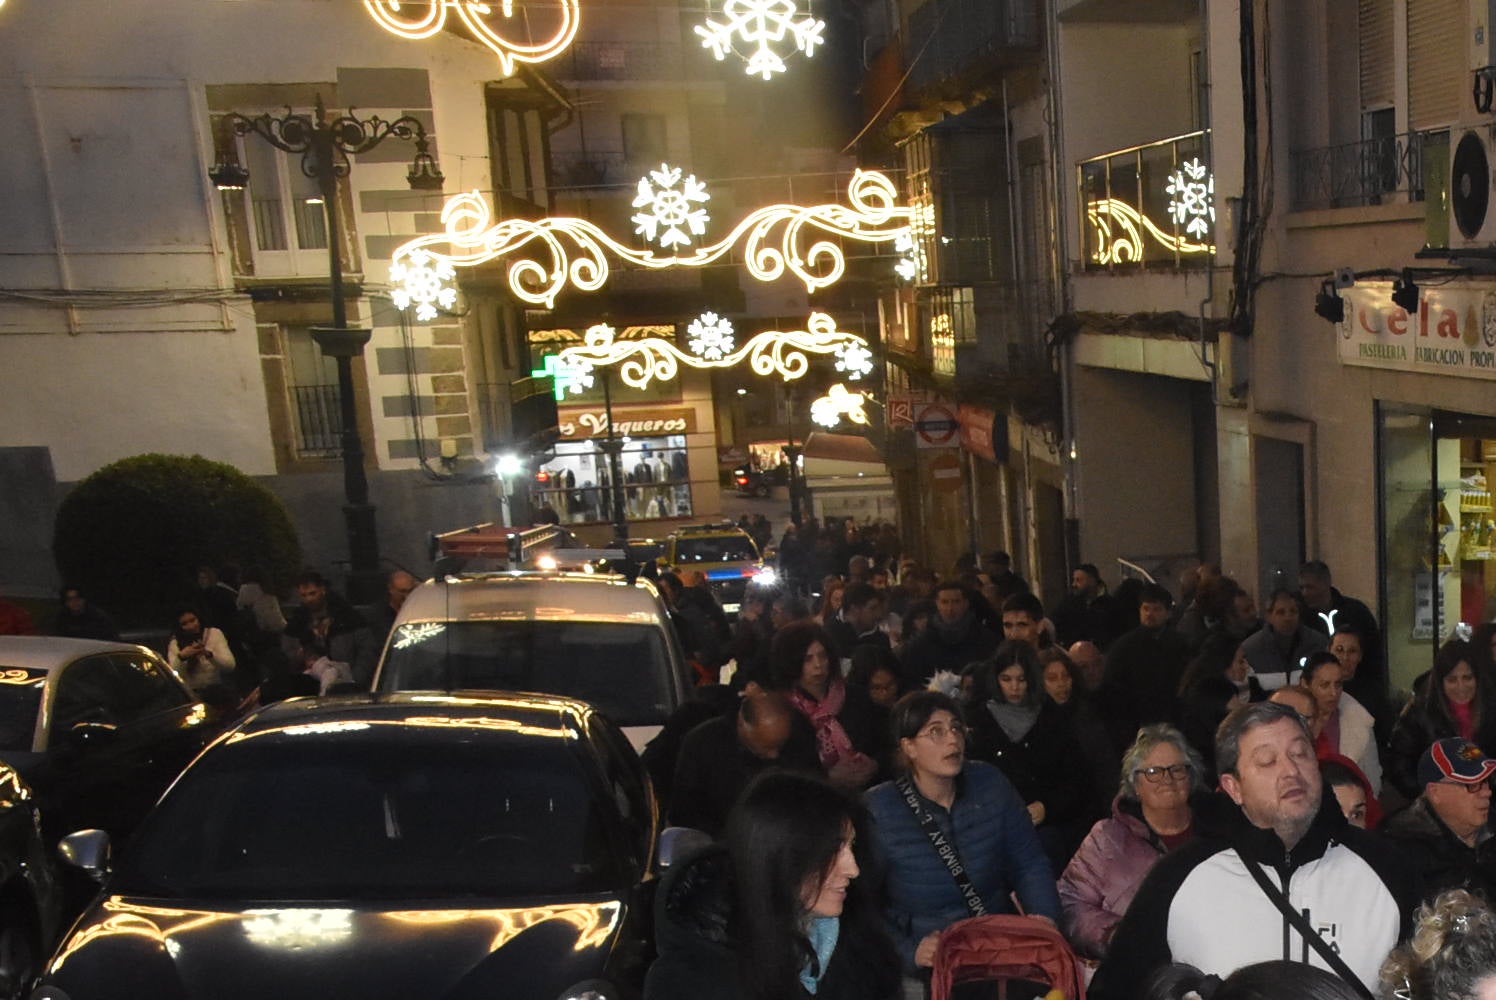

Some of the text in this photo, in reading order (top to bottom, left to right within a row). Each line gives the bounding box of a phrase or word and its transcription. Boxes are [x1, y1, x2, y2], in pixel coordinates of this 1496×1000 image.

[1359, 297, 1461, 340] Cela
[928, 831, 964, 877] BIMBAY
[960, 882, 988, 917] MBAY
